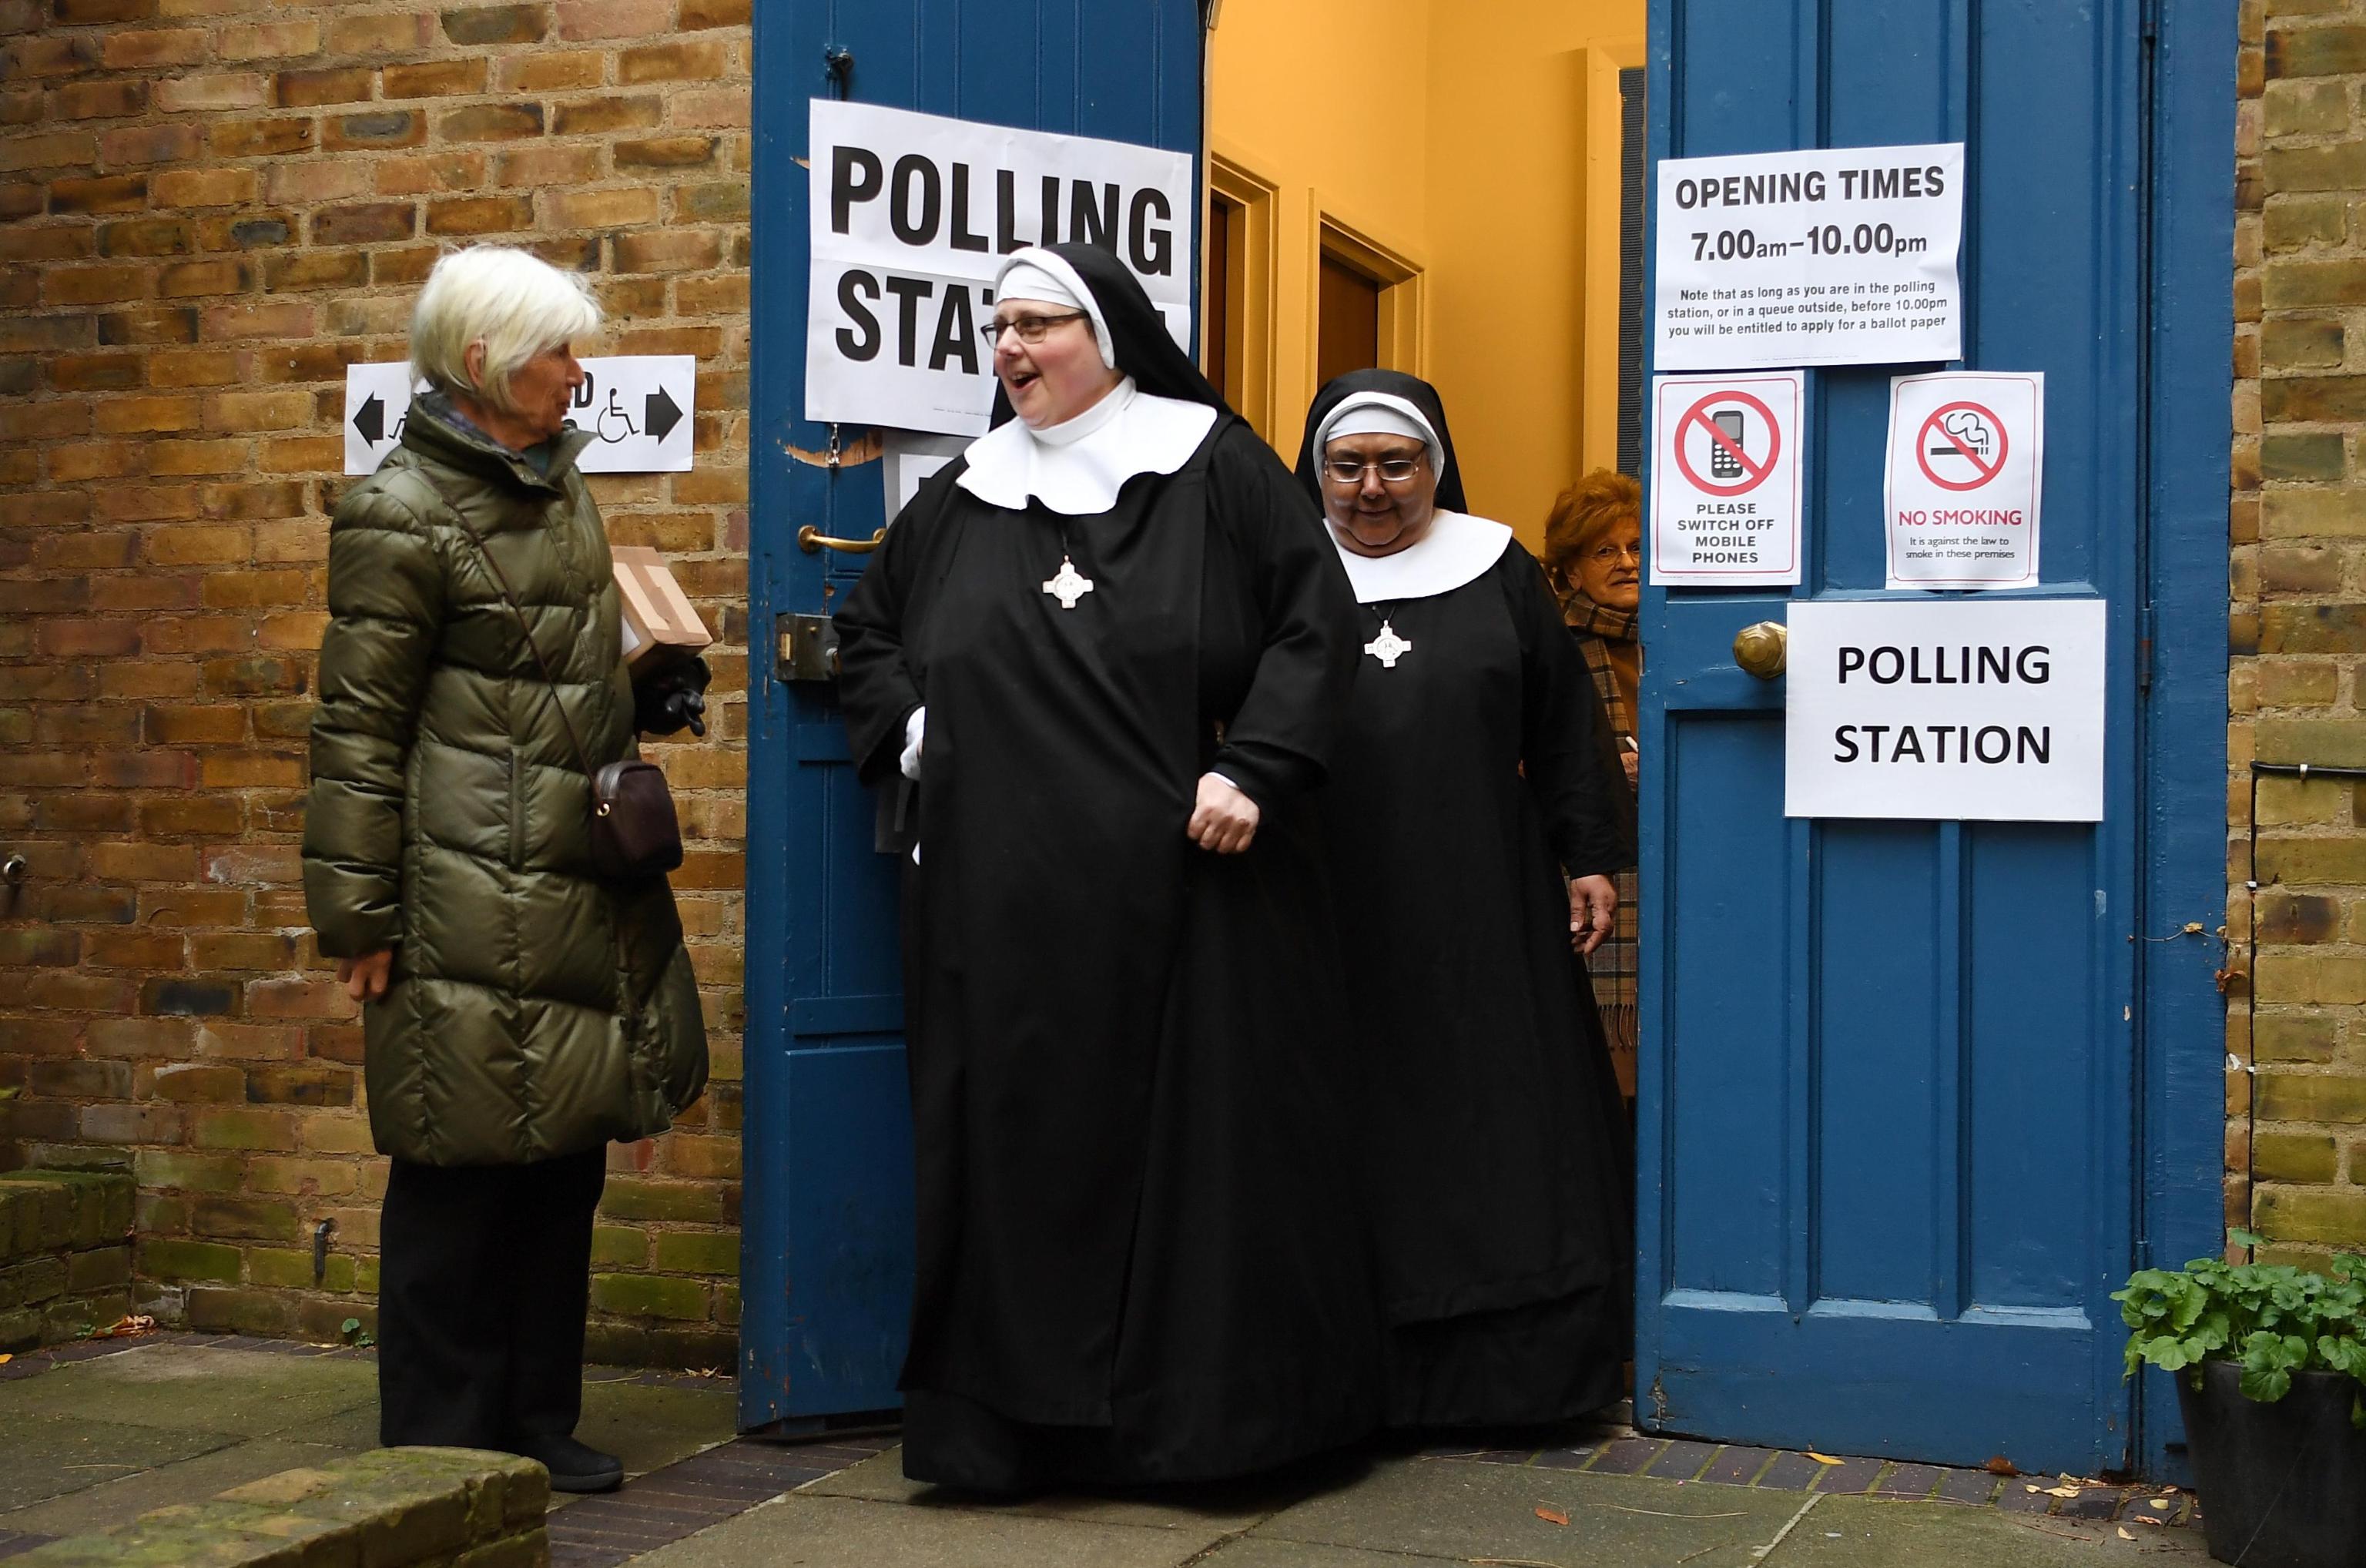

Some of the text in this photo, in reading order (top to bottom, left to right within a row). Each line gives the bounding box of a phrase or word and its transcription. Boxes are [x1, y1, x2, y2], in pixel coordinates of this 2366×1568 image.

[1675, 166, 1945, 209] OPENING TIMES
[831, 145, 1172, 276] POLLING
[1681, 281, 1935, 301] Note that as long as you are in the polling
[1667, 298, 1947, 320] station, or in a queue outside, before 10.00pm
[1668, 316, 1946, 339] you will be entitled to apply for a ballot paper
[1697, 503, 1757, 514] PLEASE
[1677, 518, 1774, 531] SWITCH OFF
[1898, 510, 2022, 526] NO SMOKING
[1695, 536, 1756, 547] MOBILE
[1909, 537, 1917, 546] It
[1919, 537, 1925, 546] is
[1928, 537, 1960, 548] against
[1963, 537, 1979, 545] the
[1981, 536, 1997, 545] law
[1692, 552, 1758, 564] PHONES
[1905, 549, 2016, 561] smoke in these premises
[1838, 645, 2050, 685] POLLING
[1834, 725, 2050, 765] STATION
